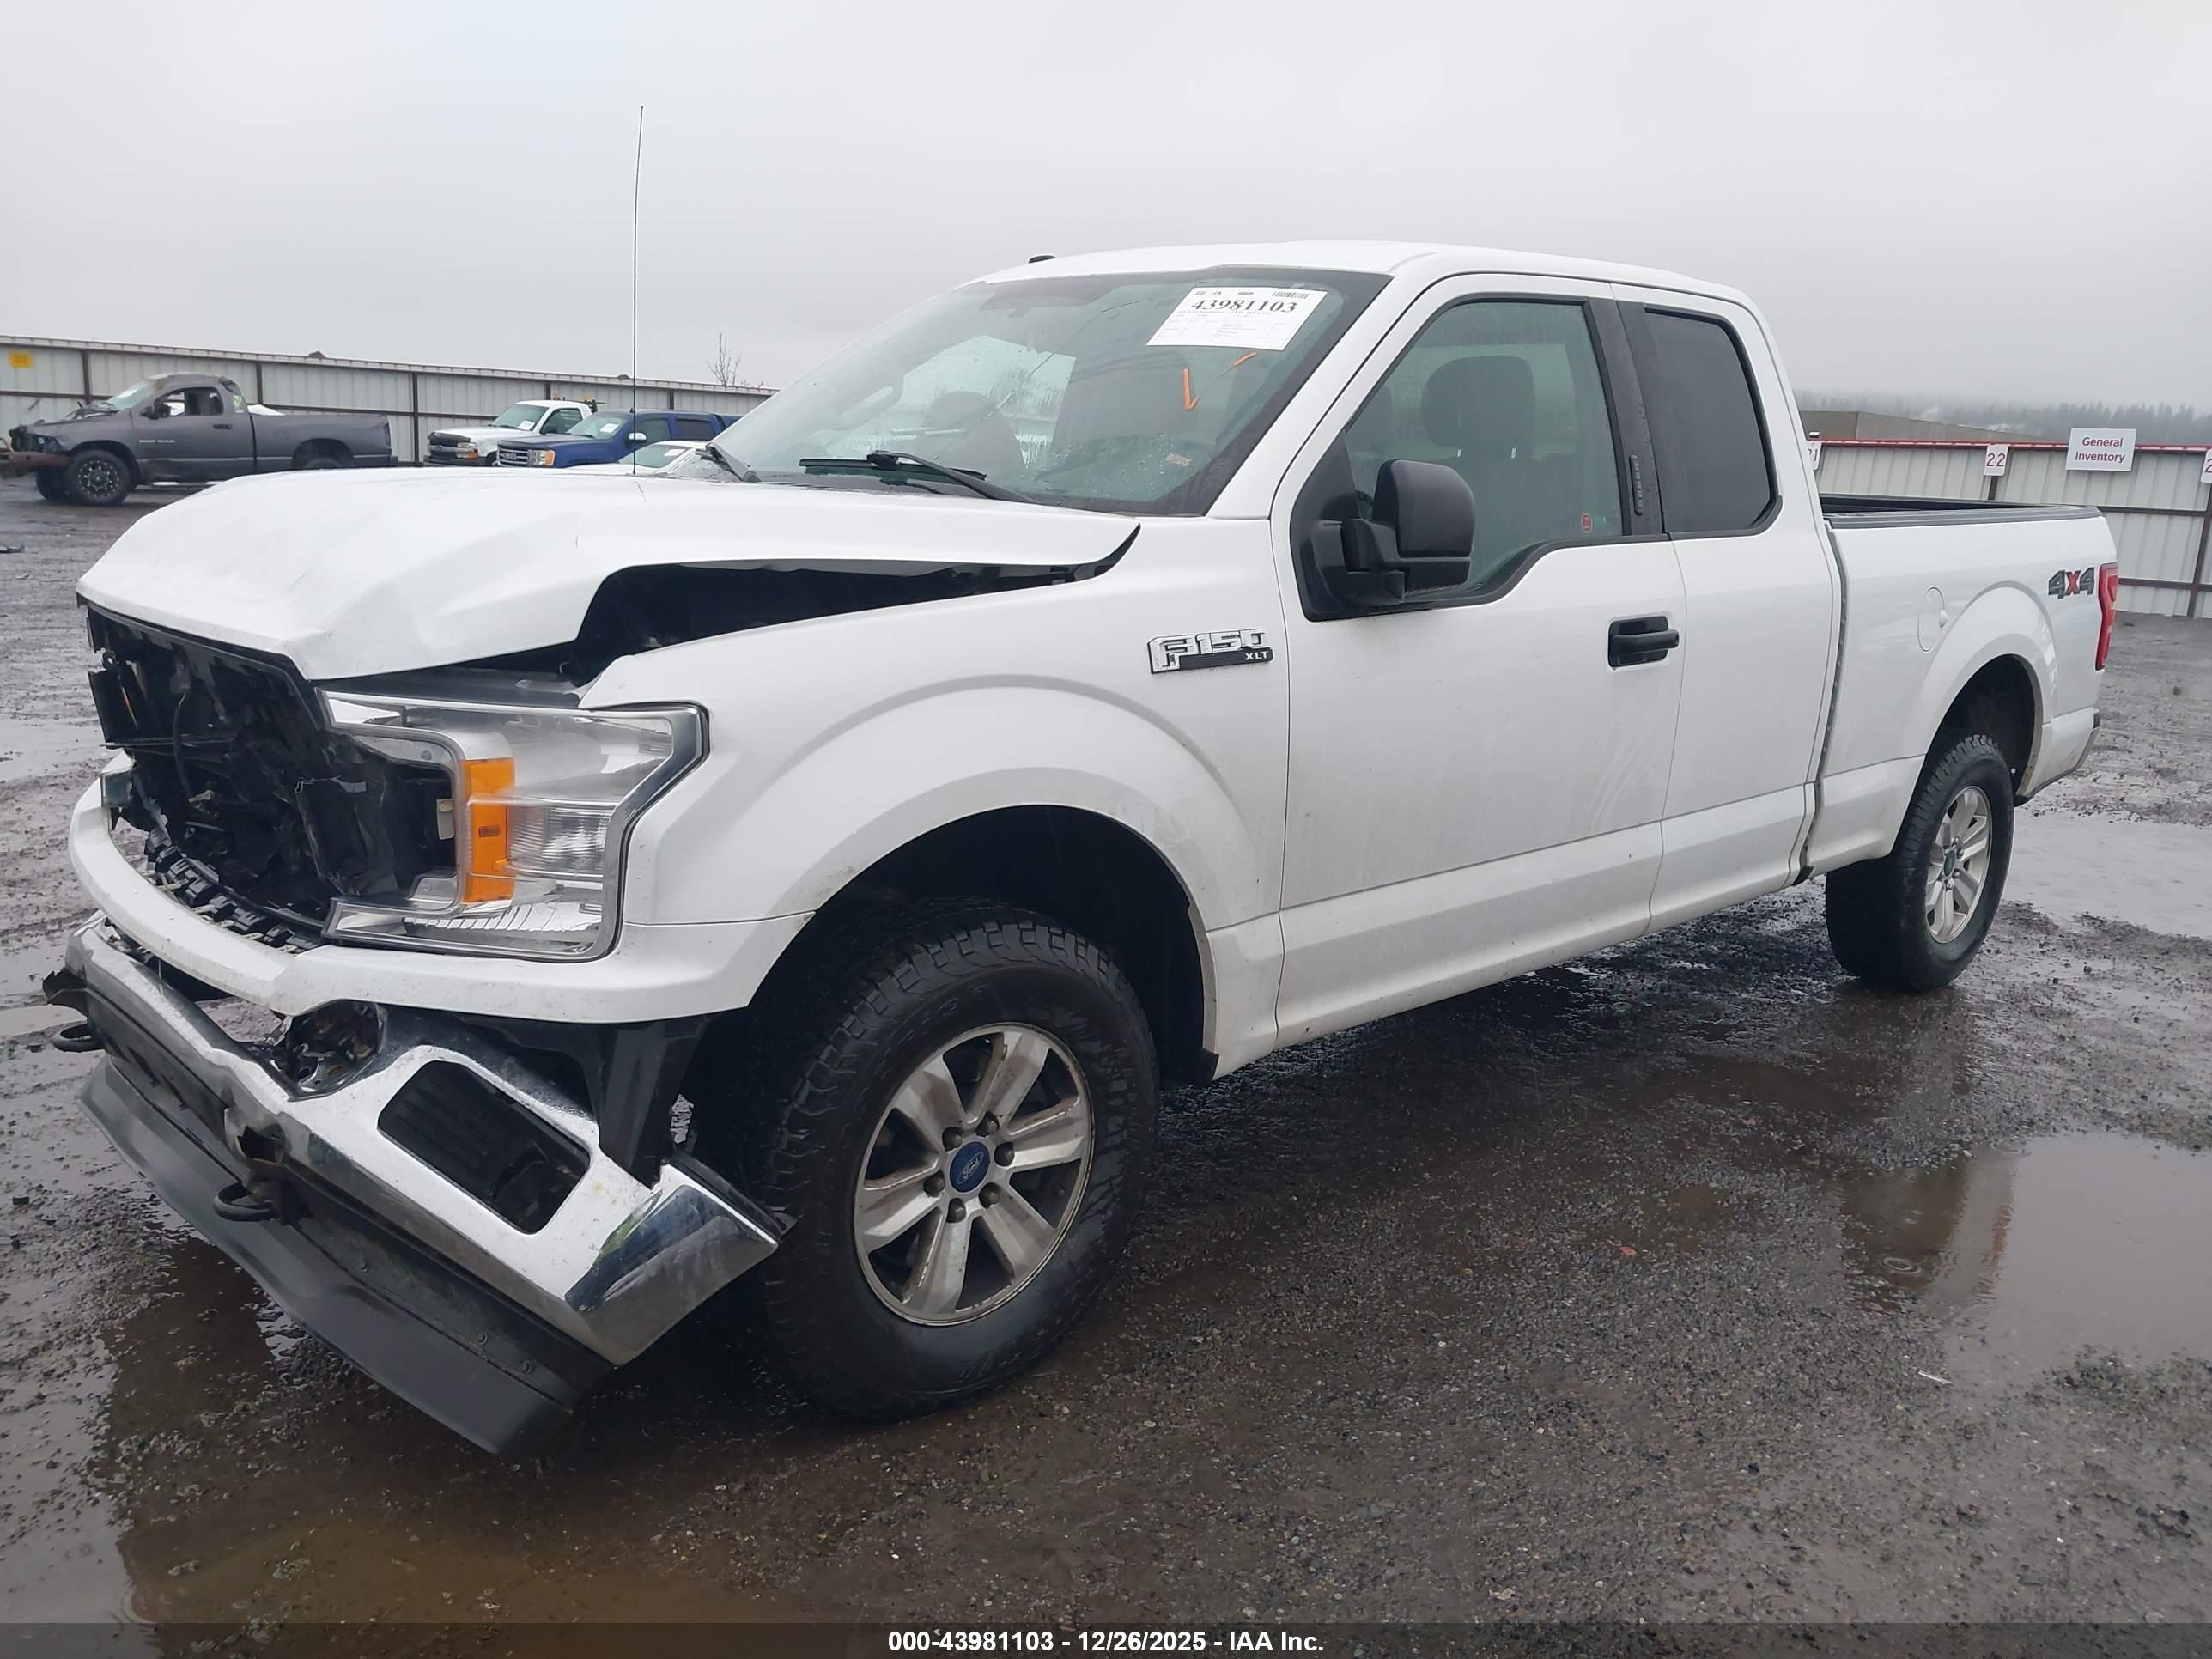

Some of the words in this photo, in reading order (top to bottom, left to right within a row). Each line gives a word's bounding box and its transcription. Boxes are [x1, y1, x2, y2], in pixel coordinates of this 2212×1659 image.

[1191, 300, 1298, 313] 43981103
[2081, 436, 2124, 447] General
[1985, 453, 2006, 467] 22
[2075, 451, 2125, 464] Inventory
[1245, 651, 1269, 660] XLT
